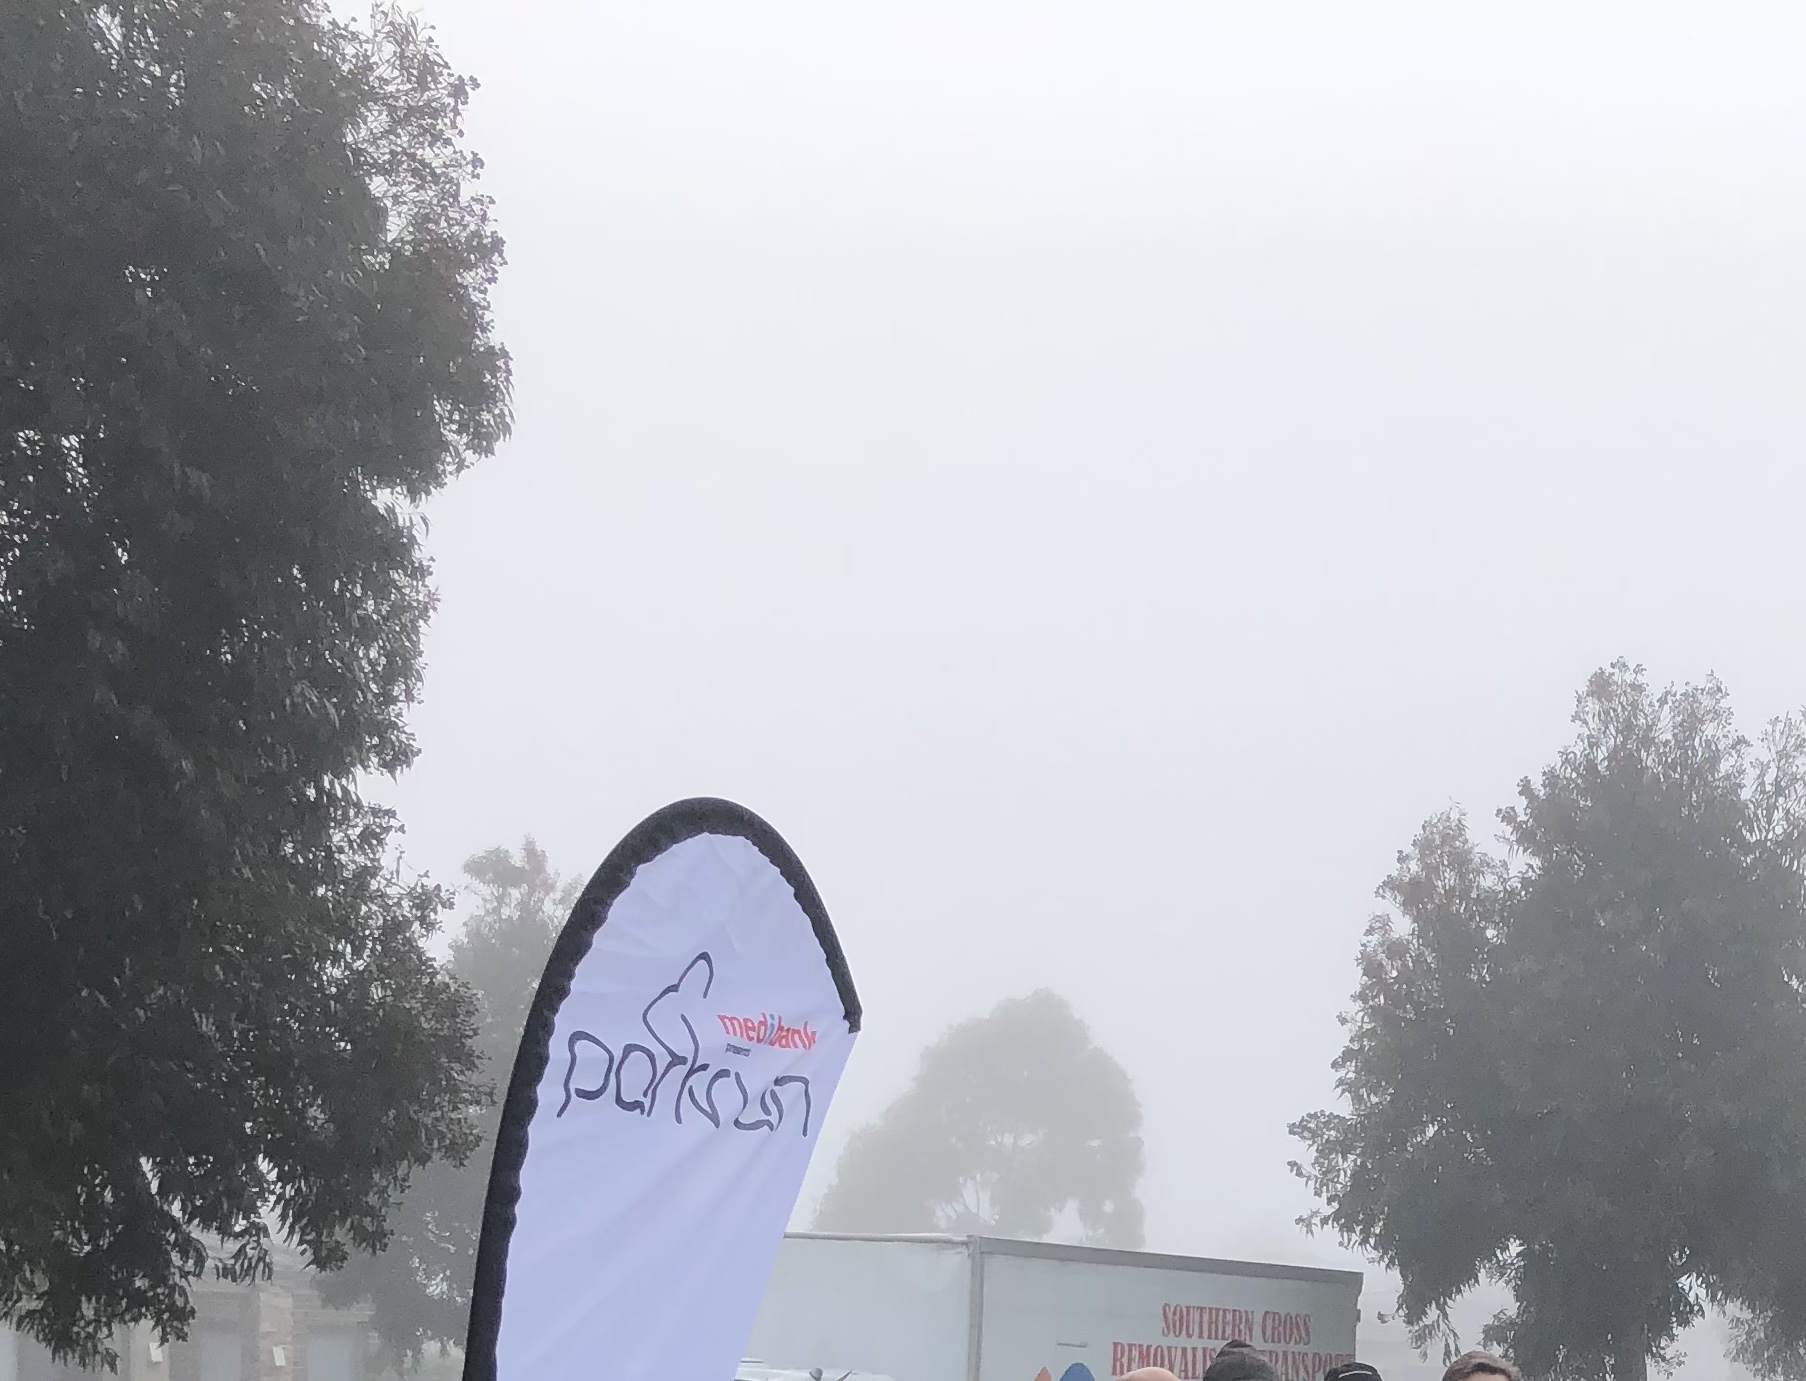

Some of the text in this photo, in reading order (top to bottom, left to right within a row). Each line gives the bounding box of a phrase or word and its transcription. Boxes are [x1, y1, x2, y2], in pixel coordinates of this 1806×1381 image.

[716, 1012, 817, 1051] medibank
[1161, 1303, 1312, 1346] SOUTHERN CROSS
